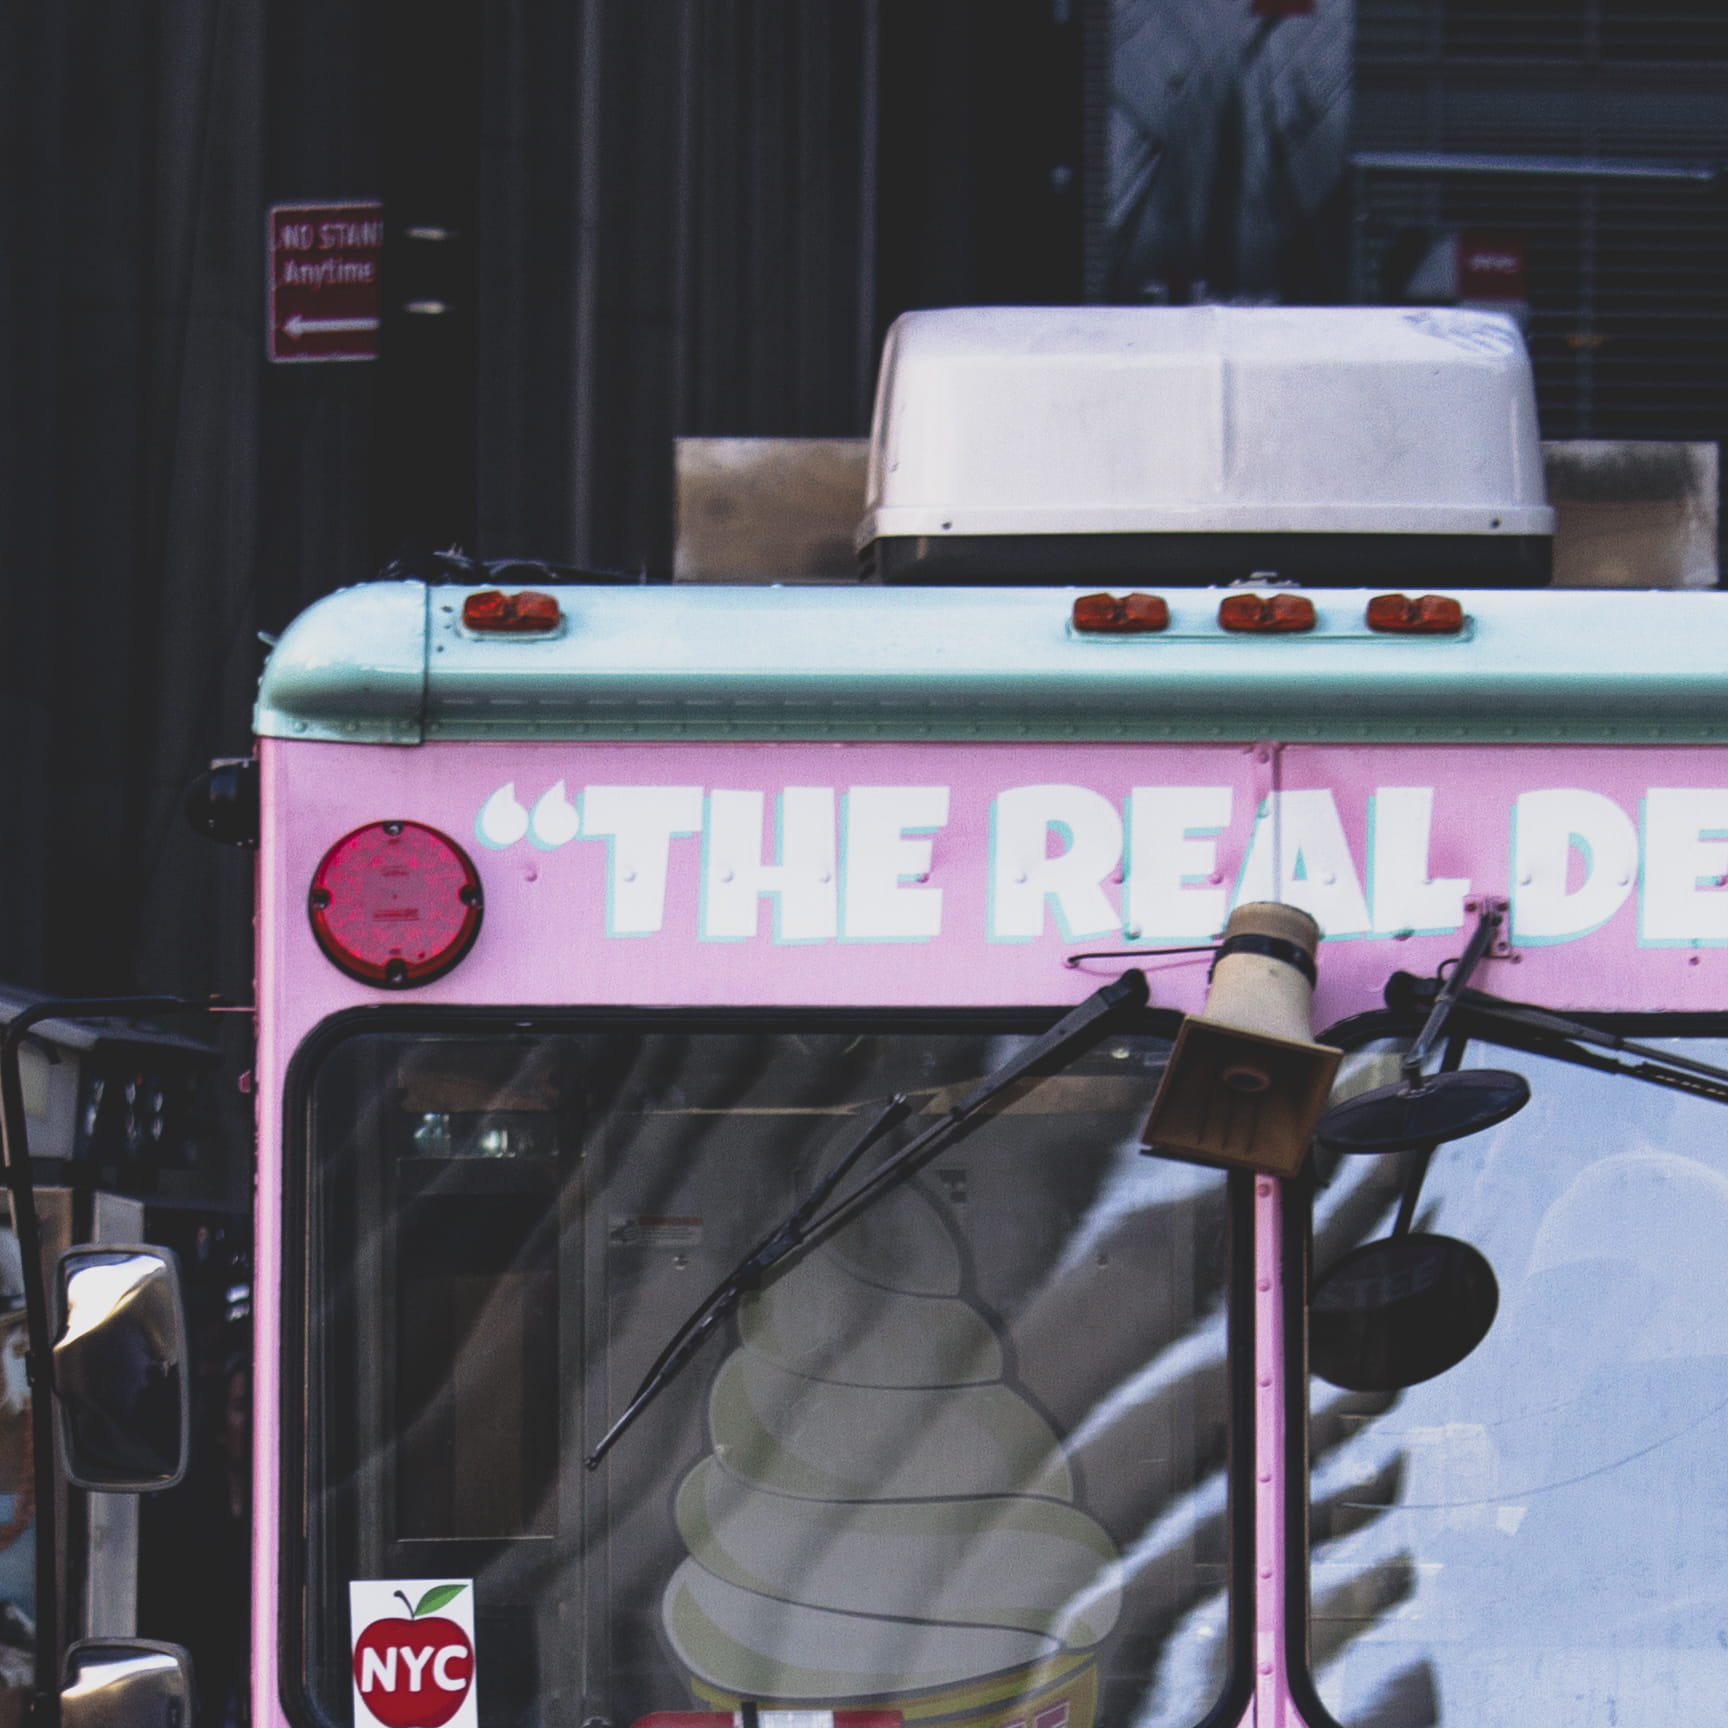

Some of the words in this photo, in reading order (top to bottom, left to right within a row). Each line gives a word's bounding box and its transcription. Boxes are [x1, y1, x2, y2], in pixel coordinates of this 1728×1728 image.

[282, 223, 315, 250] NO
[319, 220, 384, 249] STAN
[285, 259, 375, 288] Anytime
[985, 784, 1471, 945] REAL
[361, 1644, 468, 1693] NYC
